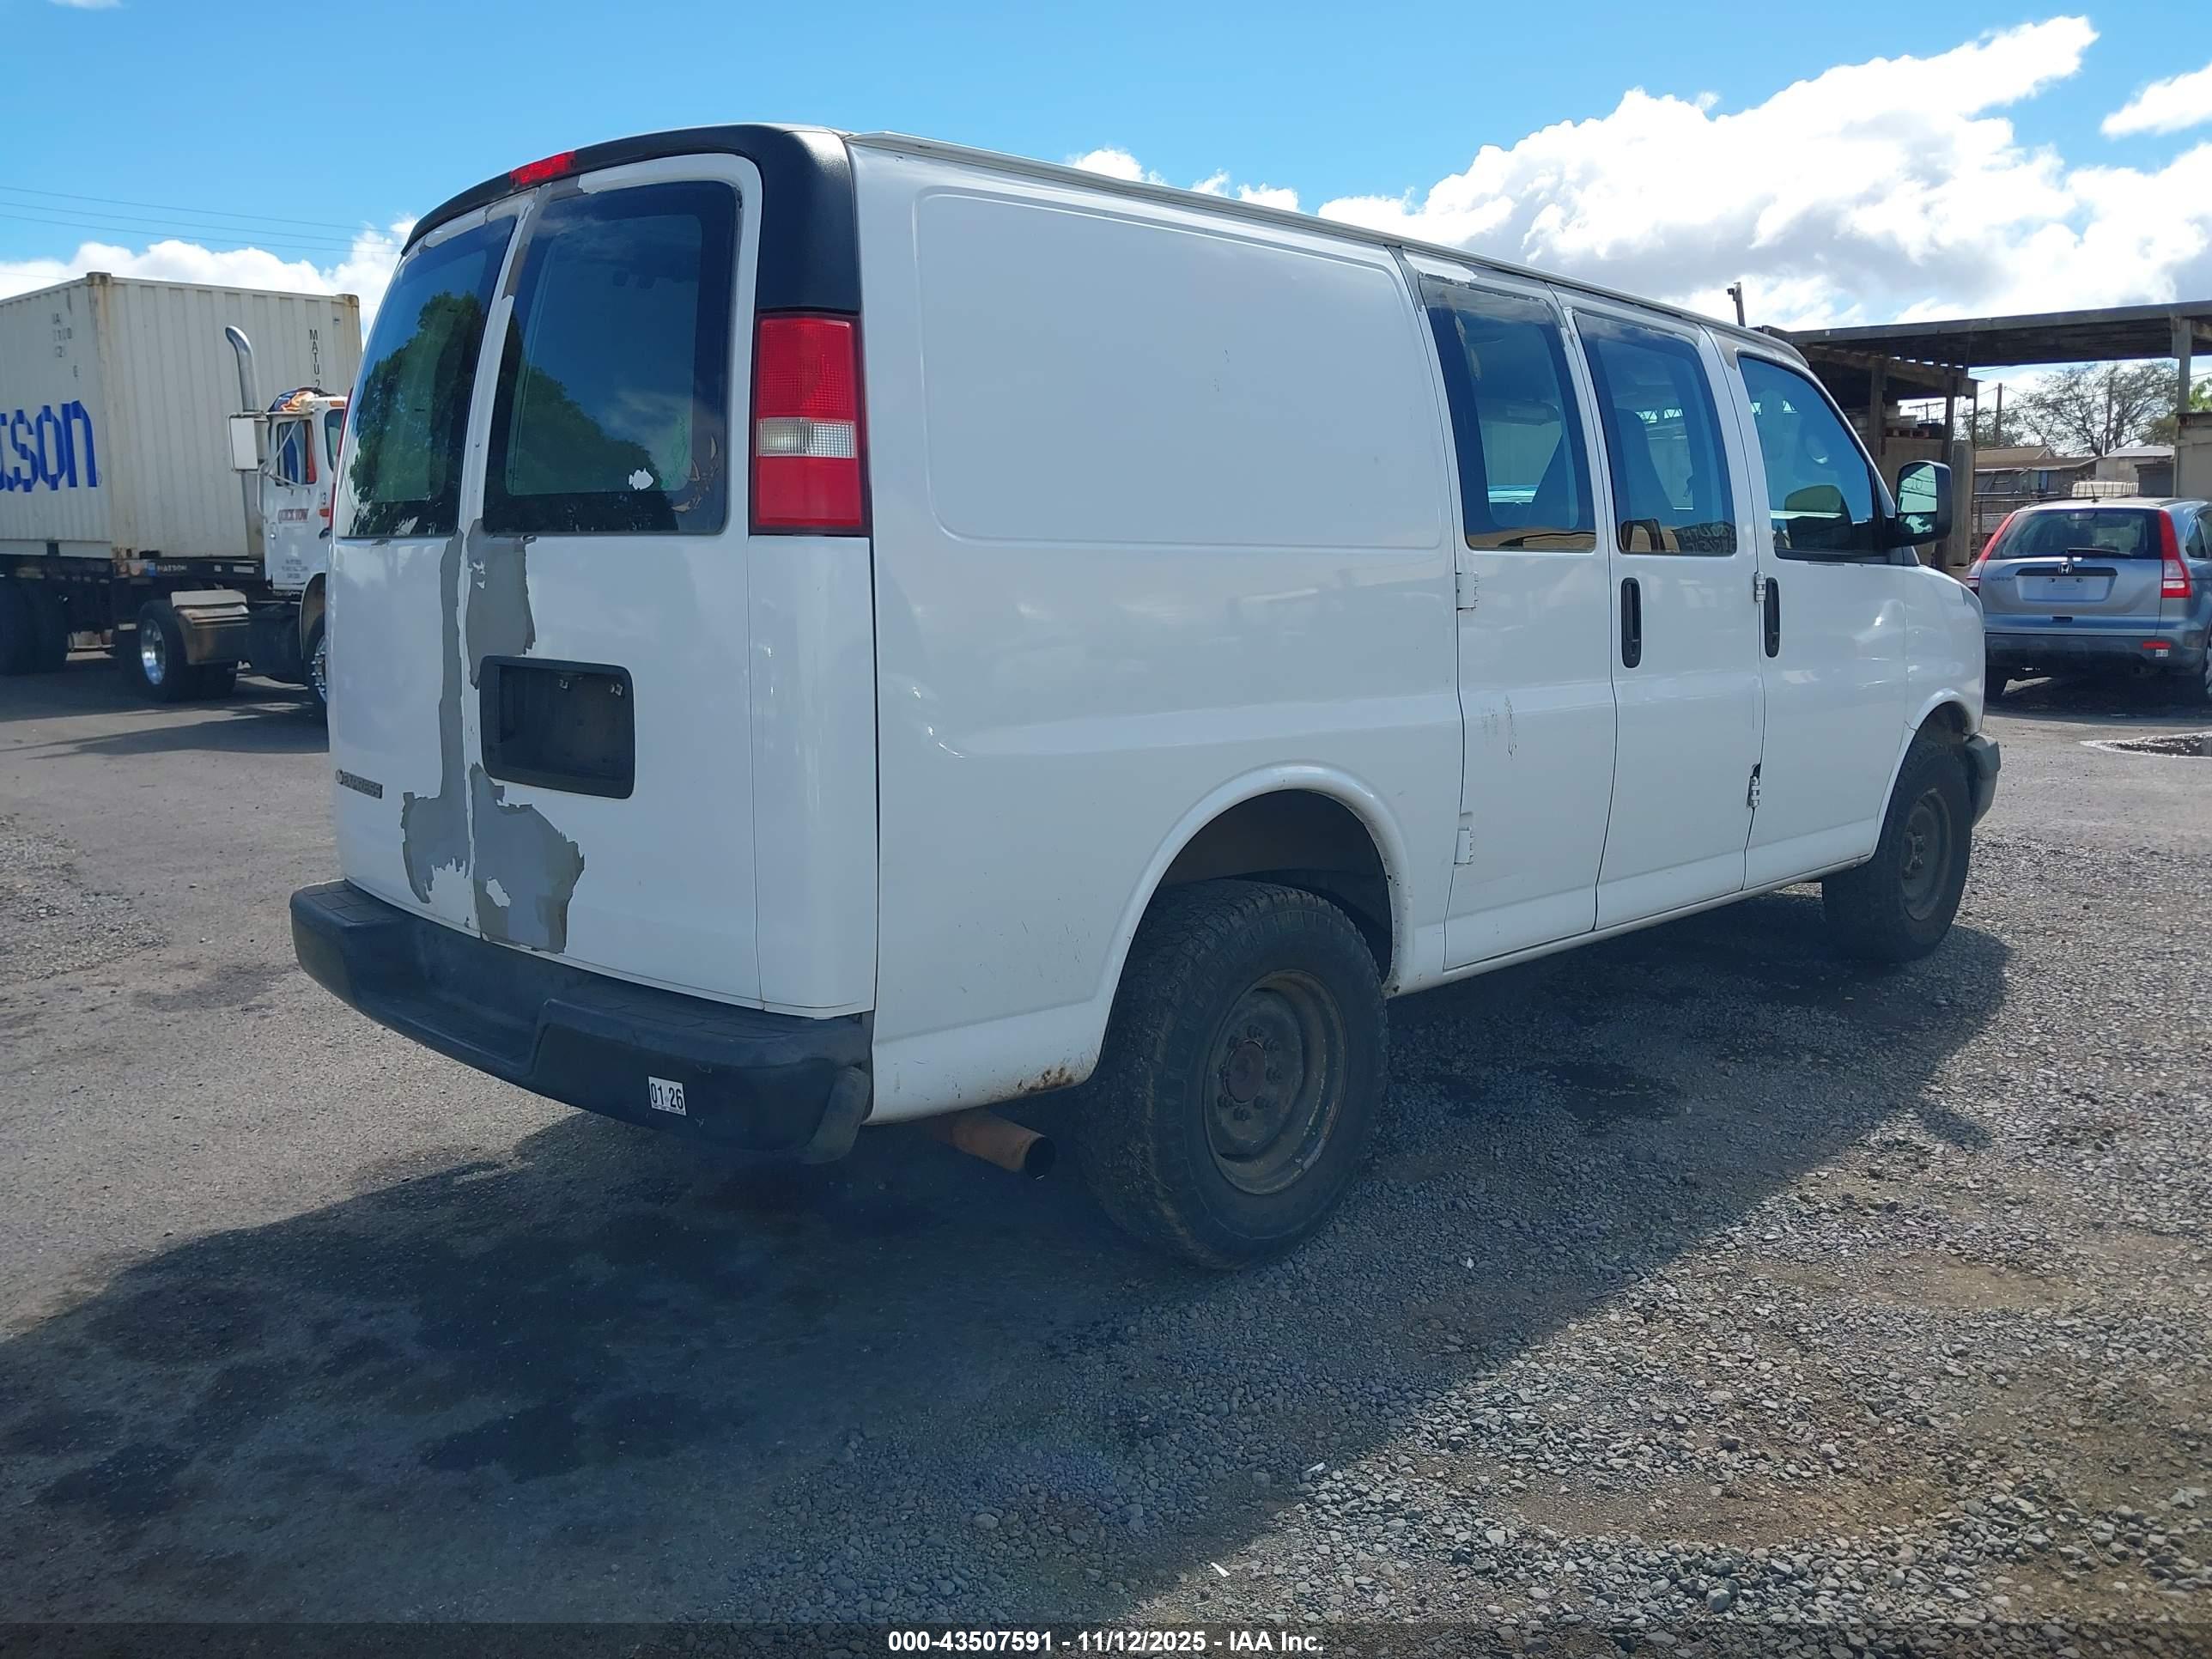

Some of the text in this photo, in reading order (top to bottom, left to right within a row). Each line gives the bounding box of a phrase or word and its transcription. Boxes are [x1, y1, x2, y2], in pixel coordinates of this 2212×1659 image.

[309, 329, 320, 375] MATU
[650, 1083, 684, 1109] 01 26
